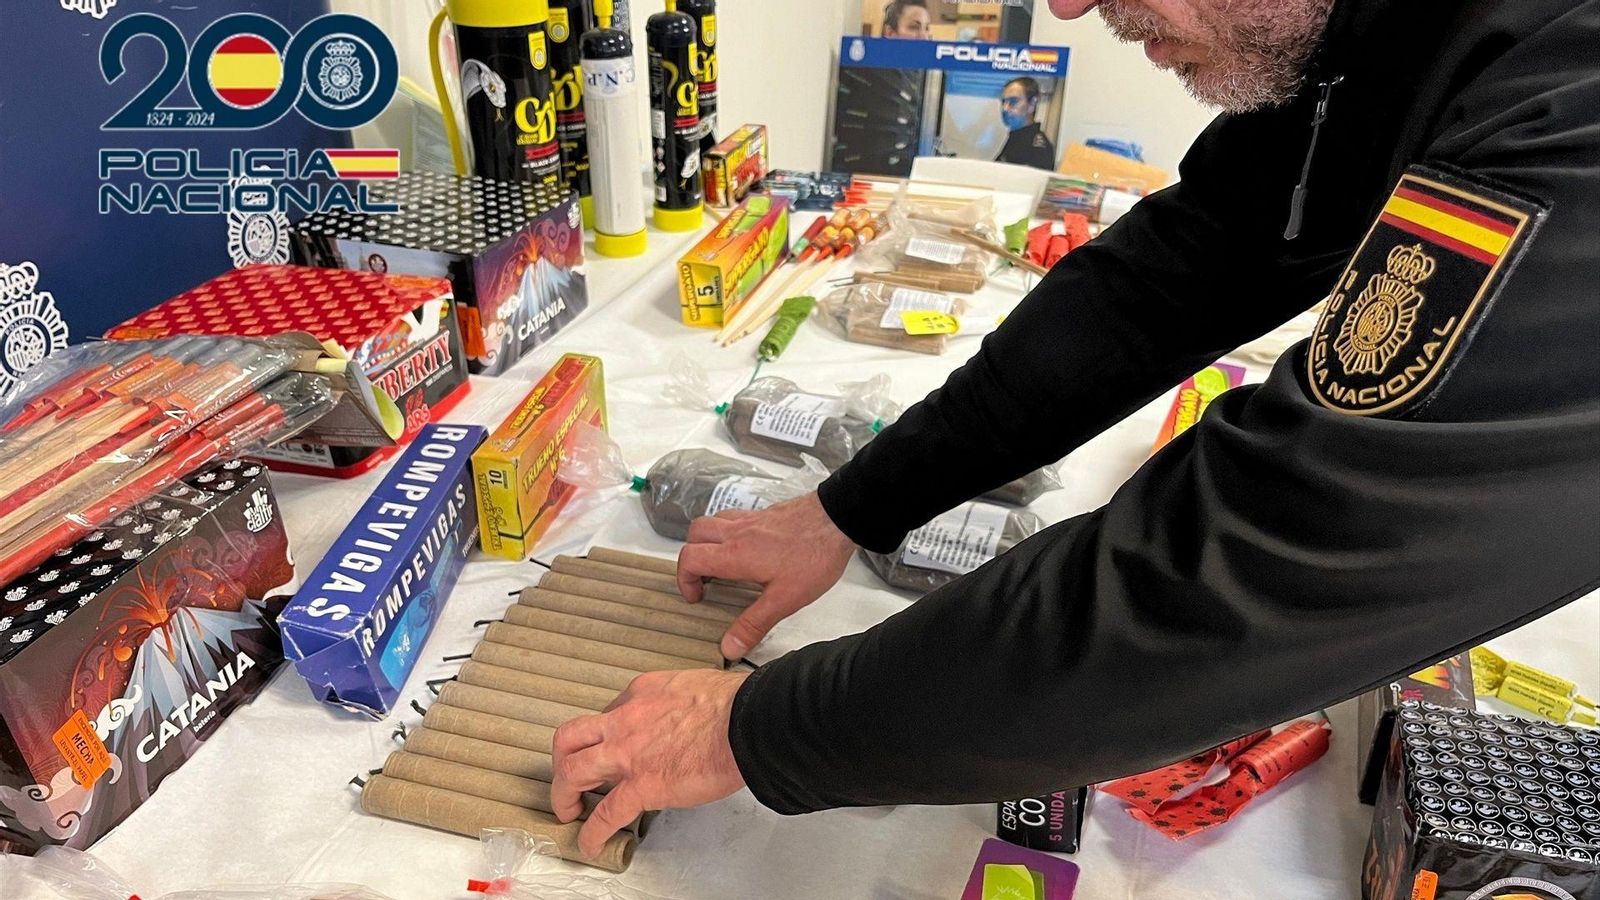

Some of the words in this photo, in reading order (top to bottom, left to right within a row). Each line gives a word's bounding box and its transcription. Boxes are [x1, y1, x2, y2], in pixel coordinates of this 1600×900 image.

[697, 285, 714, 297] 5
[517, 297, 567, 341] CATANIA
[1326, 315, 1456, 406] NACIONAL
[488, 469, 503, 486] 10
[523, 440, 556, 494] TRUENO
[307, 427, 469, 622] ROMPEVIGAS
[360, 483, 467, 658] ROMPEVIGAS
[136, 651, 257, 764] CATANIA
[71, 732, 95, 767] MECHA
[1049, 834, 1063, 842] 5
